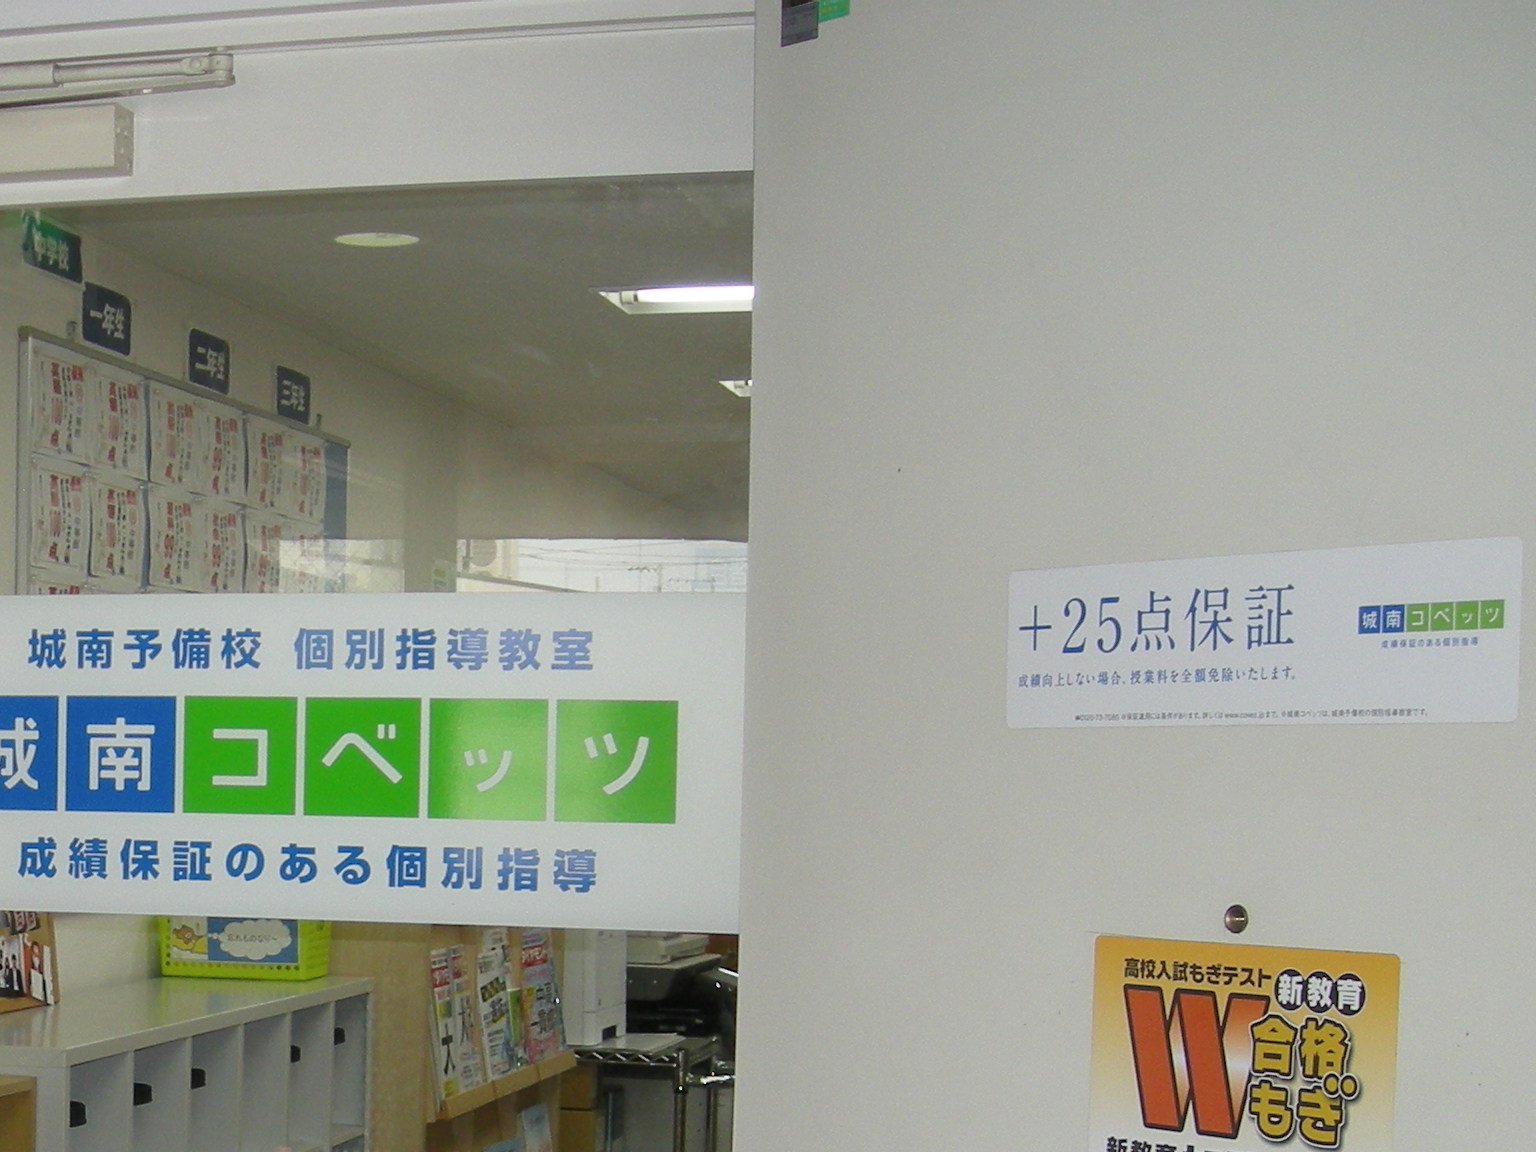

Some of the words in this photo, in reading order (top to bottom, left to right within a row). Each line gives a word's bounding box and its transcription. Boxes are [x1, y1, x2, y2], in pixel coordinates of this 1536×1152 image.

[89, 303, 125, 340] 一年生
[194, 346, 225, 380] 二年生
[1360, 604, 1502, 632] 城南コベッツ
[27, 627, 263, 671] 城南予備校
[293, 627, 595, 672] 個別指導教室
[17, 836, 598, 893] 成績保証のある個別指導
[1124, 957, 1272, 988] 高校入試もぎテスト
[1277, 973, 1364, 1011] 新教育
[1124, 984, 1270, 1139] W
[1251, 1014, 1349, 1080] 合格
